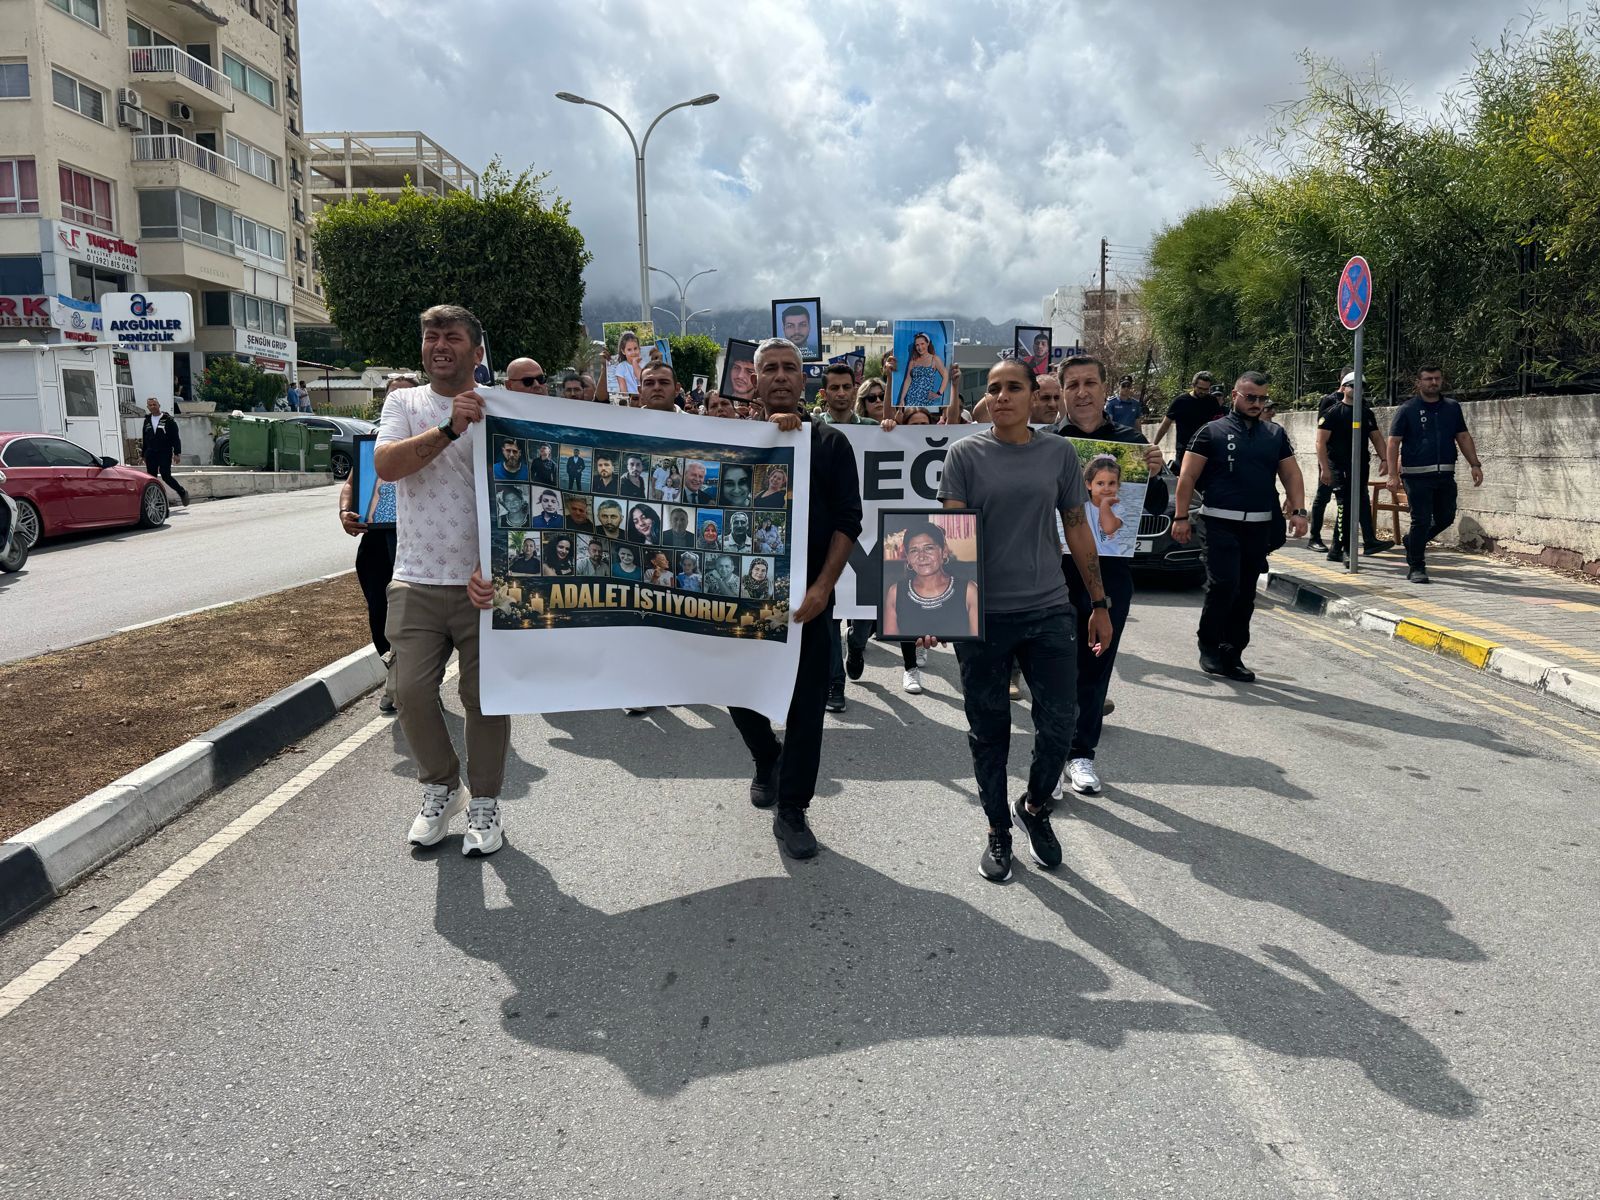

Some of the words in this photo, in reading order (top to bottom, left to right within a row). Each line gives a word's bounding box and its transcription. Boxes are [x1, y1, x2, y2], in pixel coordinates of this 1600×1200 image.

[110, 260, 120, 268] 815
[110, 317, 182, 331] AKGÜNLER
[118, 331, 175, 342] DENİZCİLİK
[247, 334, 271, 348] ŞENGÜN
[272, 340, 287, 350] GRUP
[550, 583, 632, 610] ADALET
[633, 583, 738, 624] İSTİYORUZ
